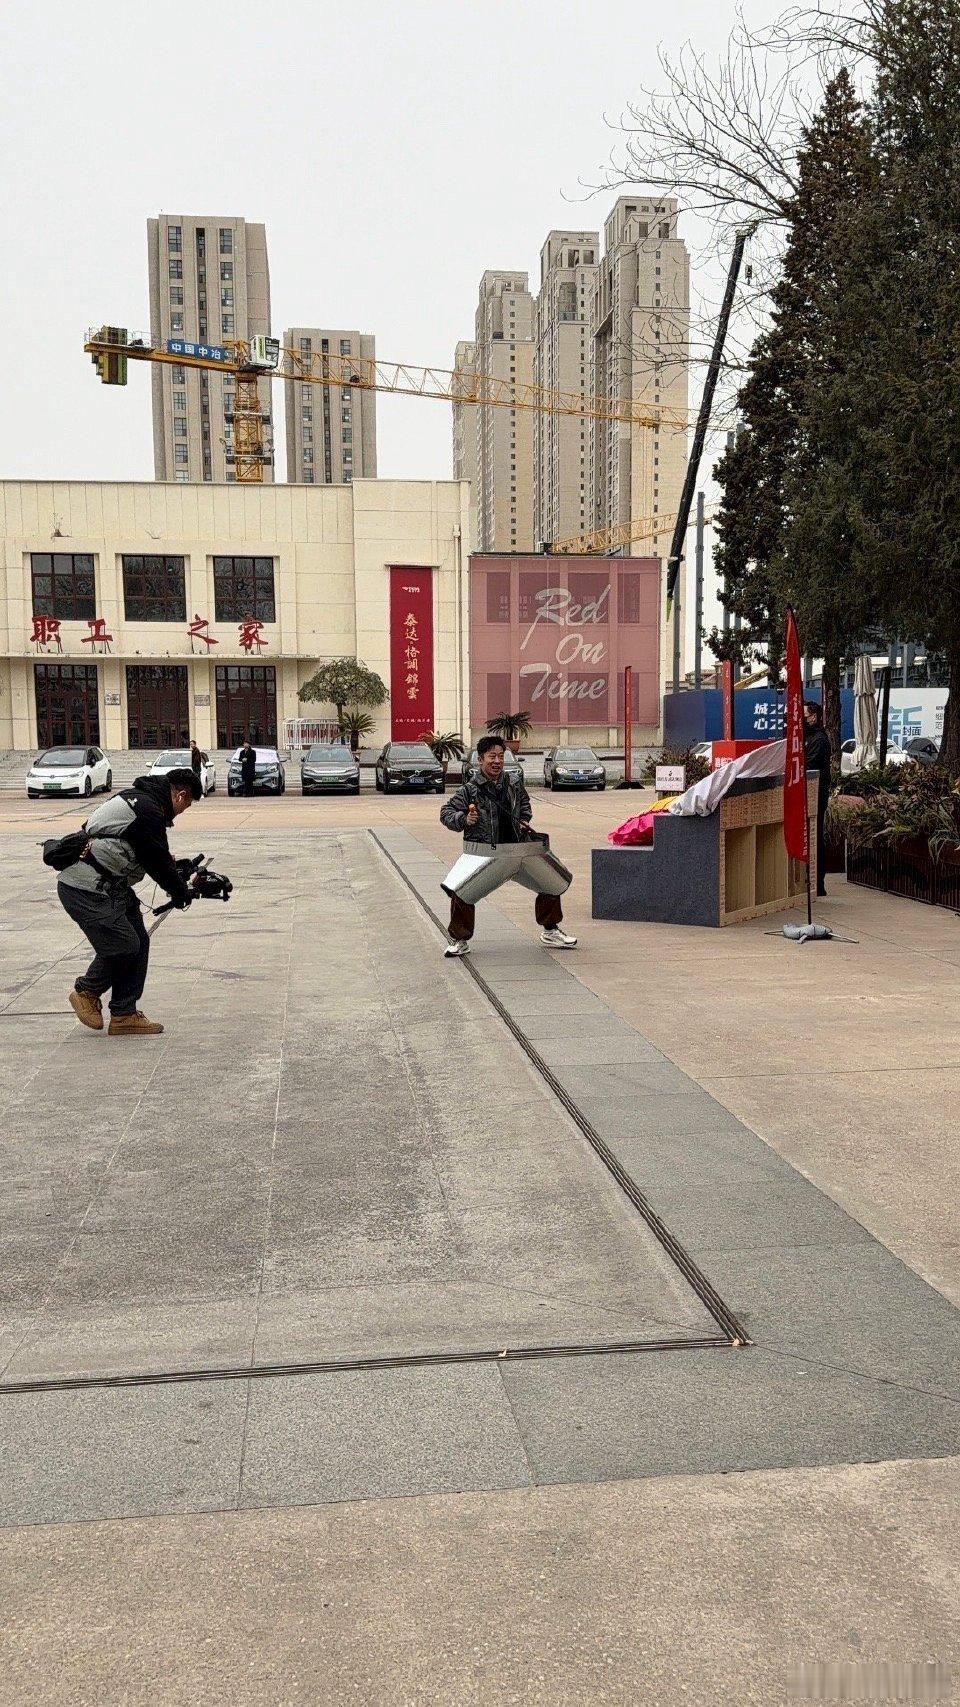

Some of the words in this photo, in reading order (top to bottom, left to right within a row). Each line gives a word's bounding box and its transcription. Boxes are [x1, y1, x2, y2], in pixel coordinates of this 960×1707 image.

[171, 342, 222, 360] 中国中冶
[30, 614, 269, 650] 职工之家
[519, 583, 612, 651] Red
[555, 632, 608, 666] On
[519, 661, 609, 703] Time
[753, 702, 788, 715] 城之
[753, 717, 788, 731] 心之
